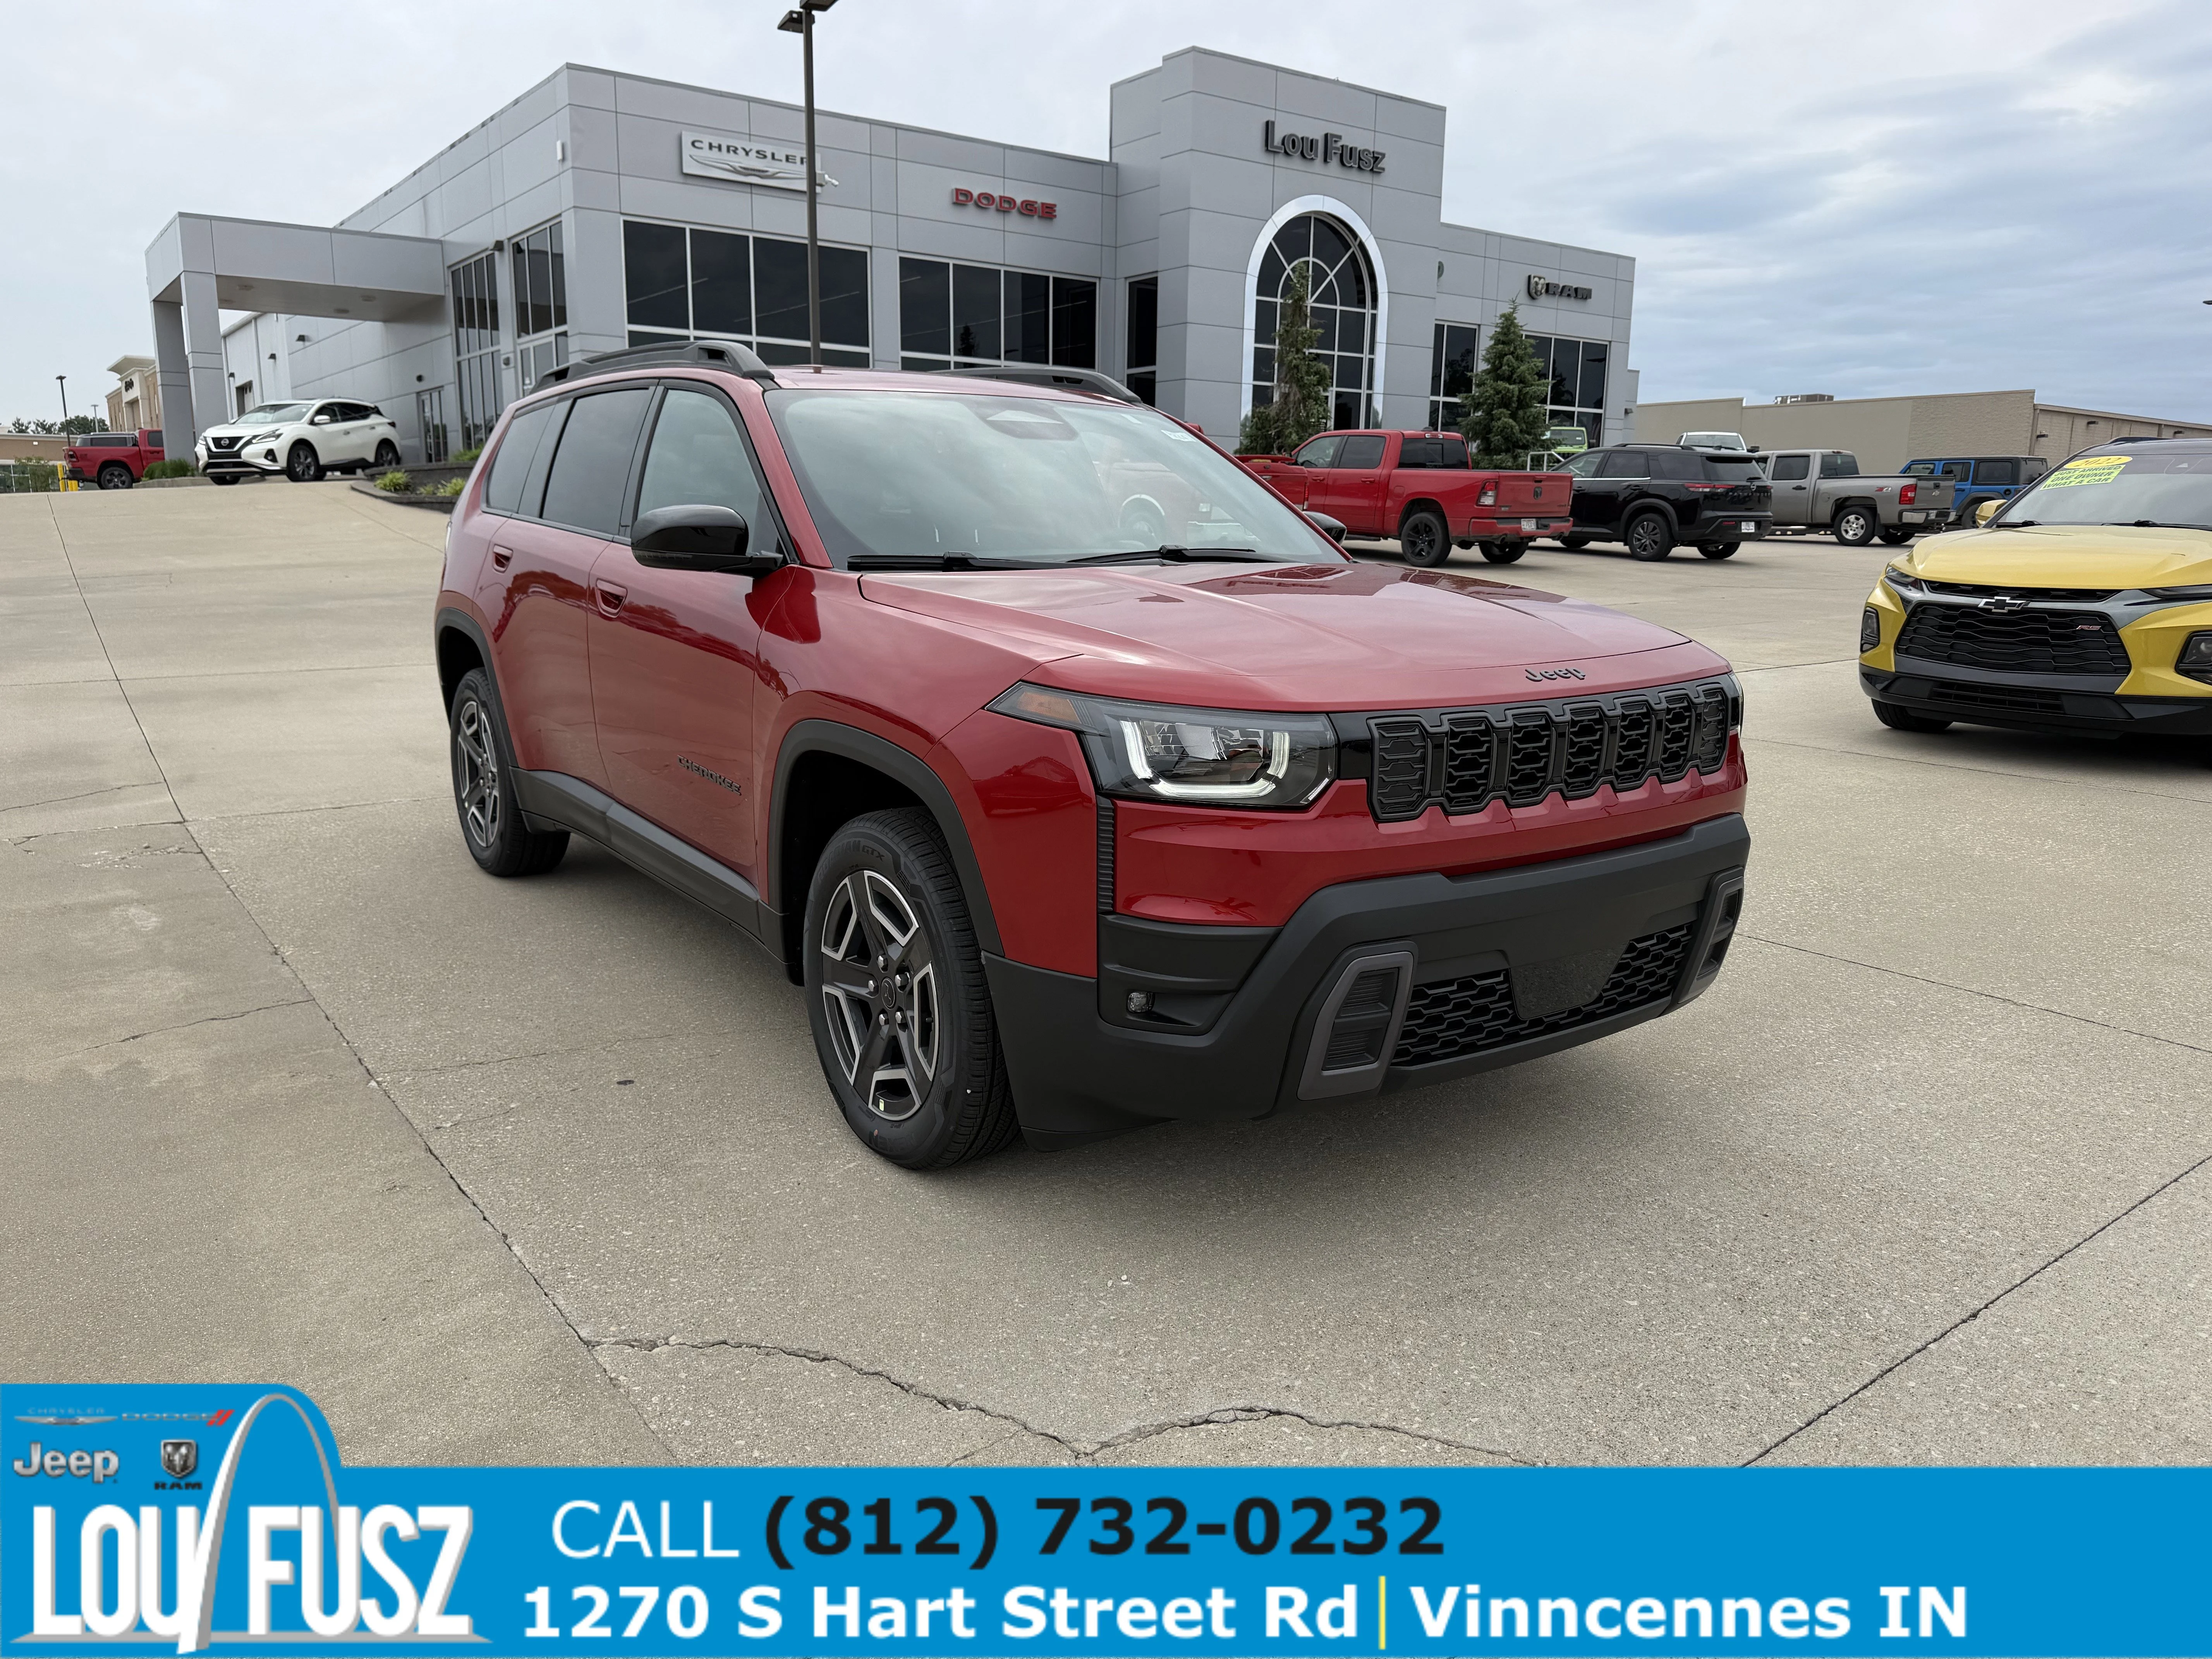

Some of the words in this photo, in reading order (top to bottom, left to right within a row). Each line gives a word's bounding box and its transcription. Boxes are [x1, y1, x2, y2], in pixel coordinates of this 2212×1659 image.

[1265, 120, 1319, 160] Lou
[1324, 132, 1386, 173] Fusz
[952, 188, 1057, 218] DODGE
[1545, 282, 1592, 300] RAM
[2073, 457, 2122, 467] 2022
[2074, 471, 2114, 479] OWNER
[2042, 480, 2075, 489] WHAT
[1525, 667, 1586, 682] Jeep
[677, 755, 742, 796] CHEROKEE
[862, 845, 885, 862] GTX
